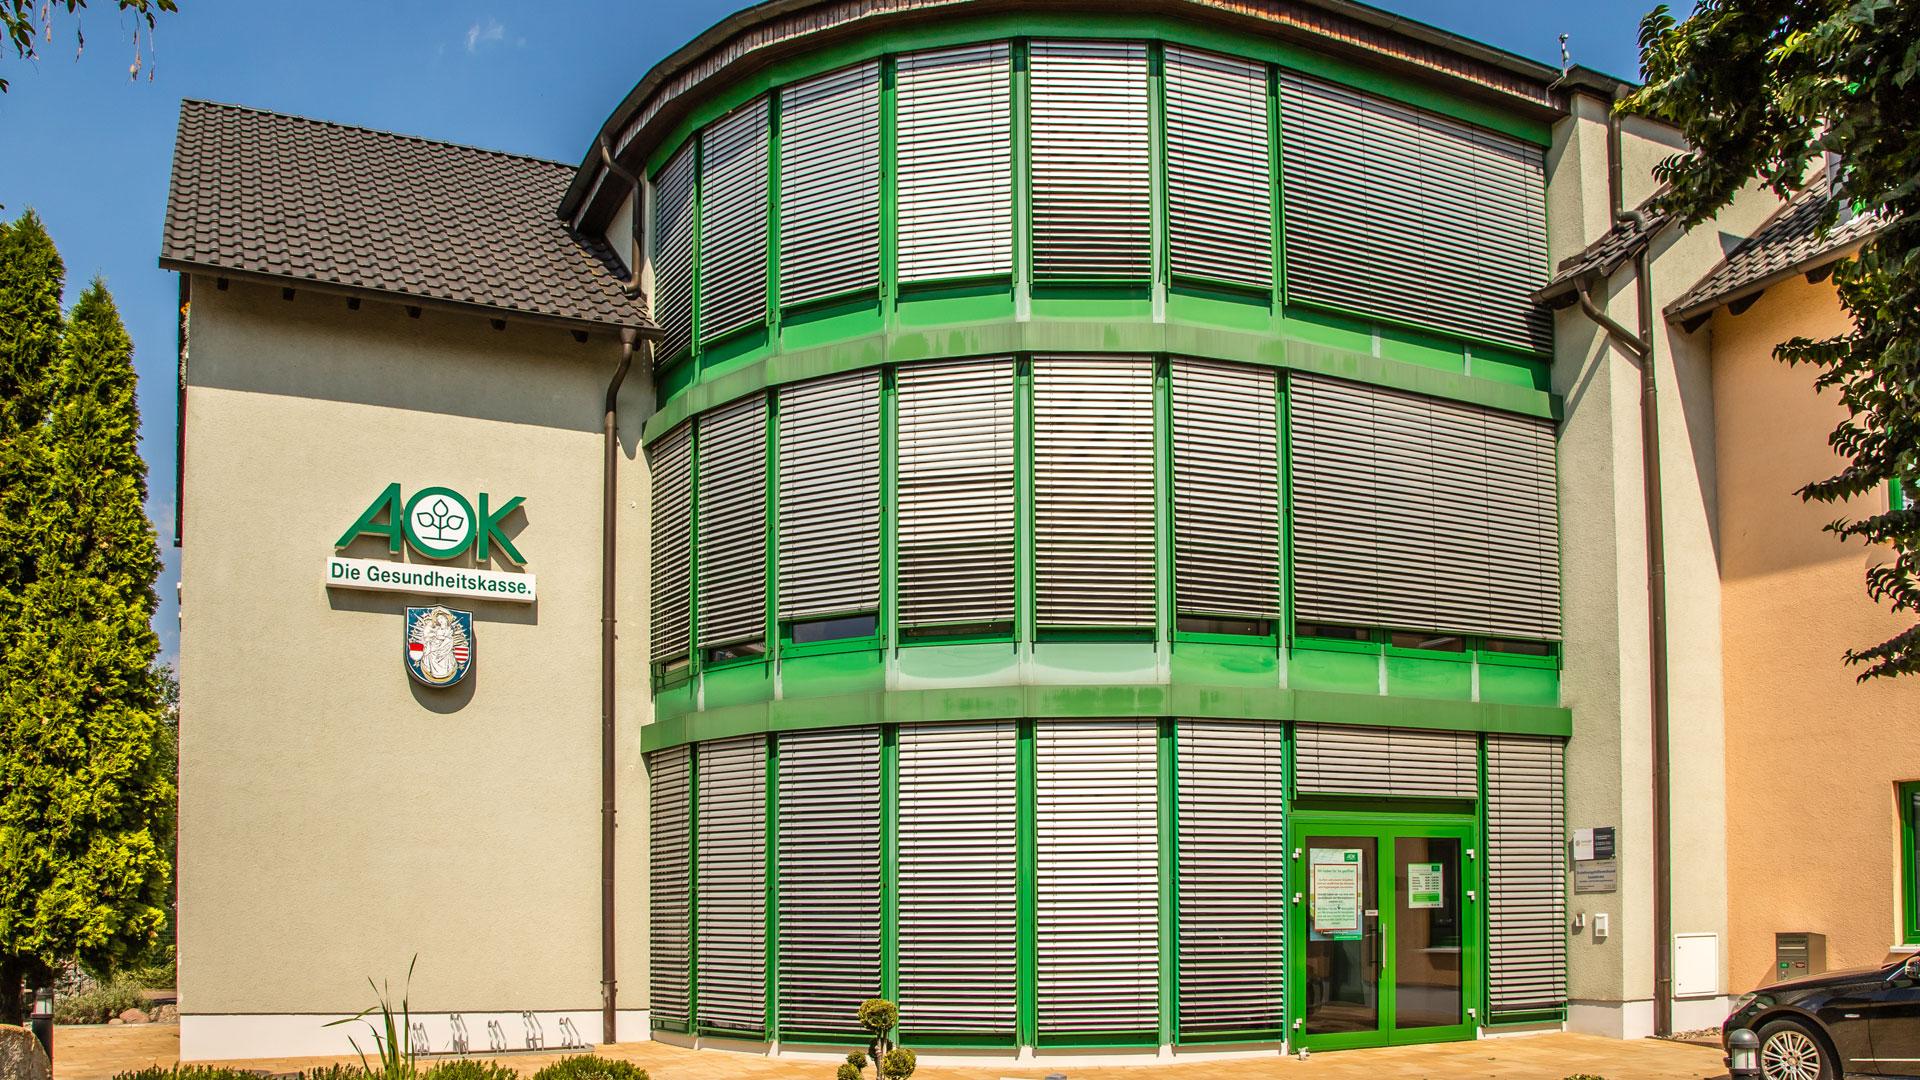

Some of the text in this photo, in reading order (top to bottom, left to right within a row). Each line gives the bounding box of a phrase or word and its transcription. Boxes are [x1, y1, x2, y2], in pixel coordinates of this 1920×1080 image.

[335, 482, 528, 565] AOK
[331, 562, 532, 594] Die Gesundheitskasse.
